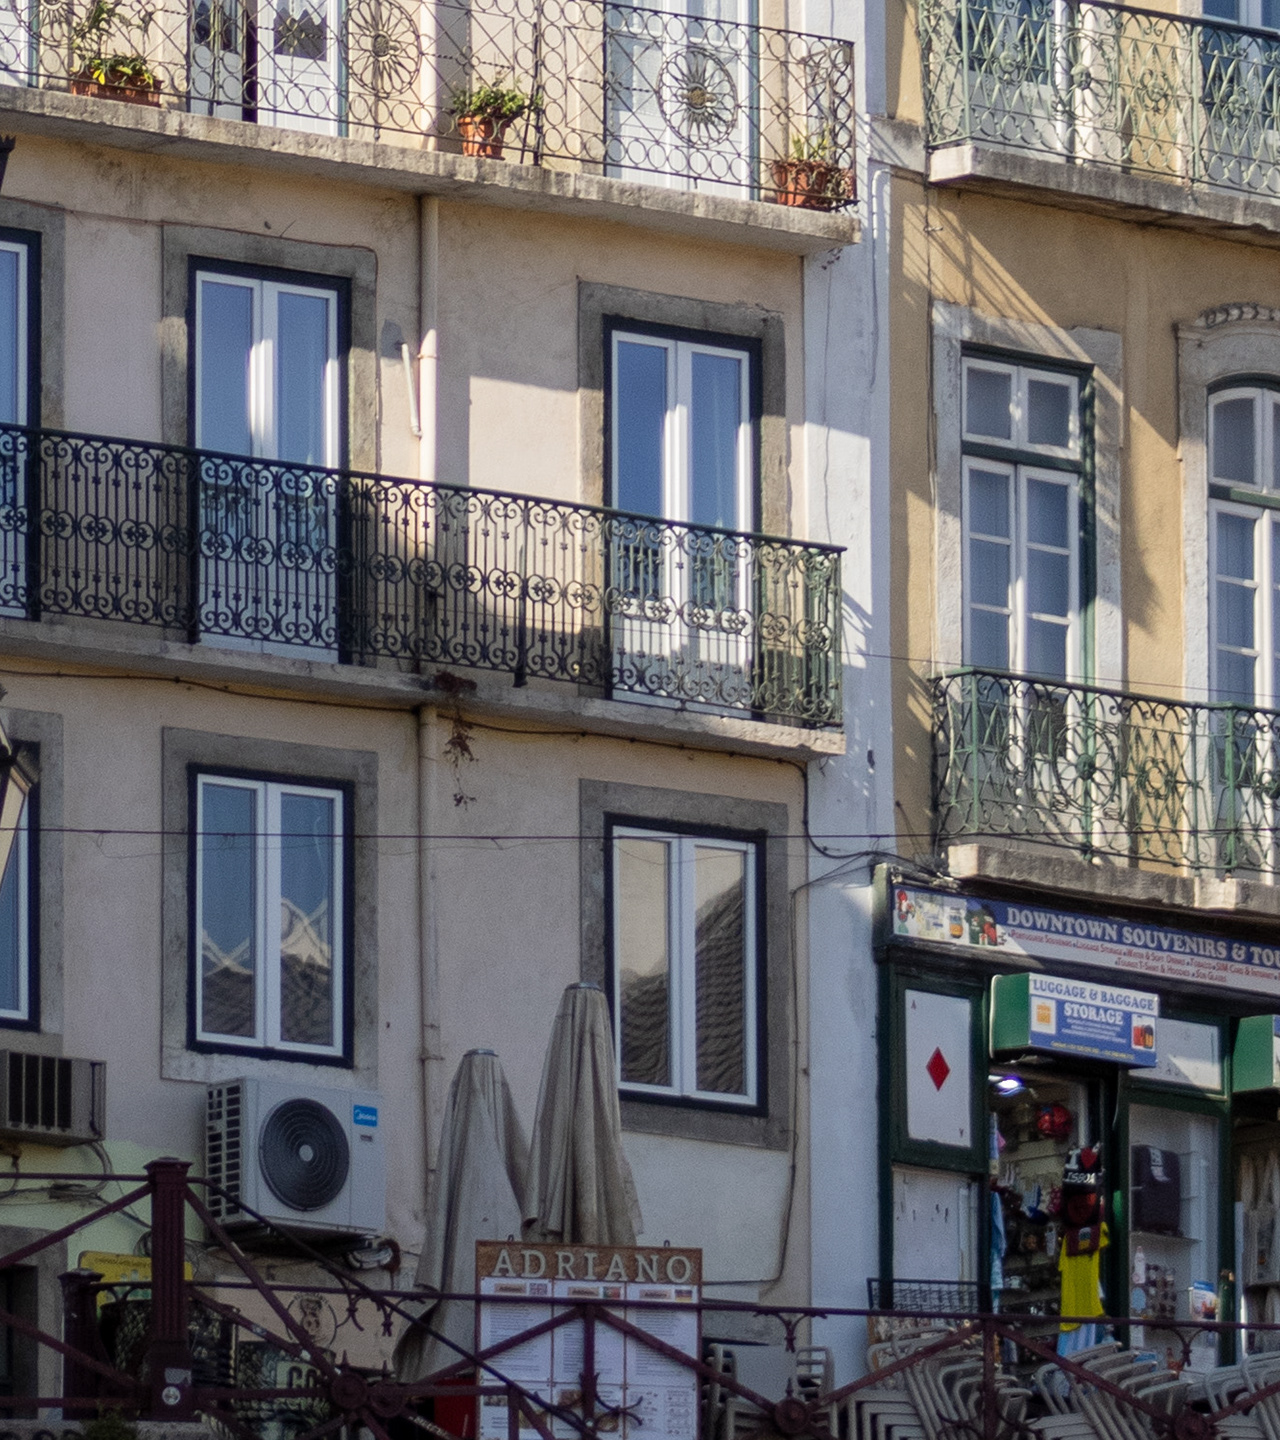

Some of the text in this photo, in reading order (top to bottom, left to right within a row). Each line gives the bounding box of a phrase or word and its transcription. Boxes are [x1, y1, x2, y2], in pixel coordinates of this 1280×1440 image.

[1007, 907, 1118, 943] DOWNTOWN
[1122, 926, 1226, 960] SOUVENIRS
[1232, 944, 1248, 961] &
[1033, 979, 1155, 1011] LUGGAGE & BAGGAGE
[1064, 1002, 1124, 1025] STORAGE
[491, 1249, 692, 1283] ADRIANO
